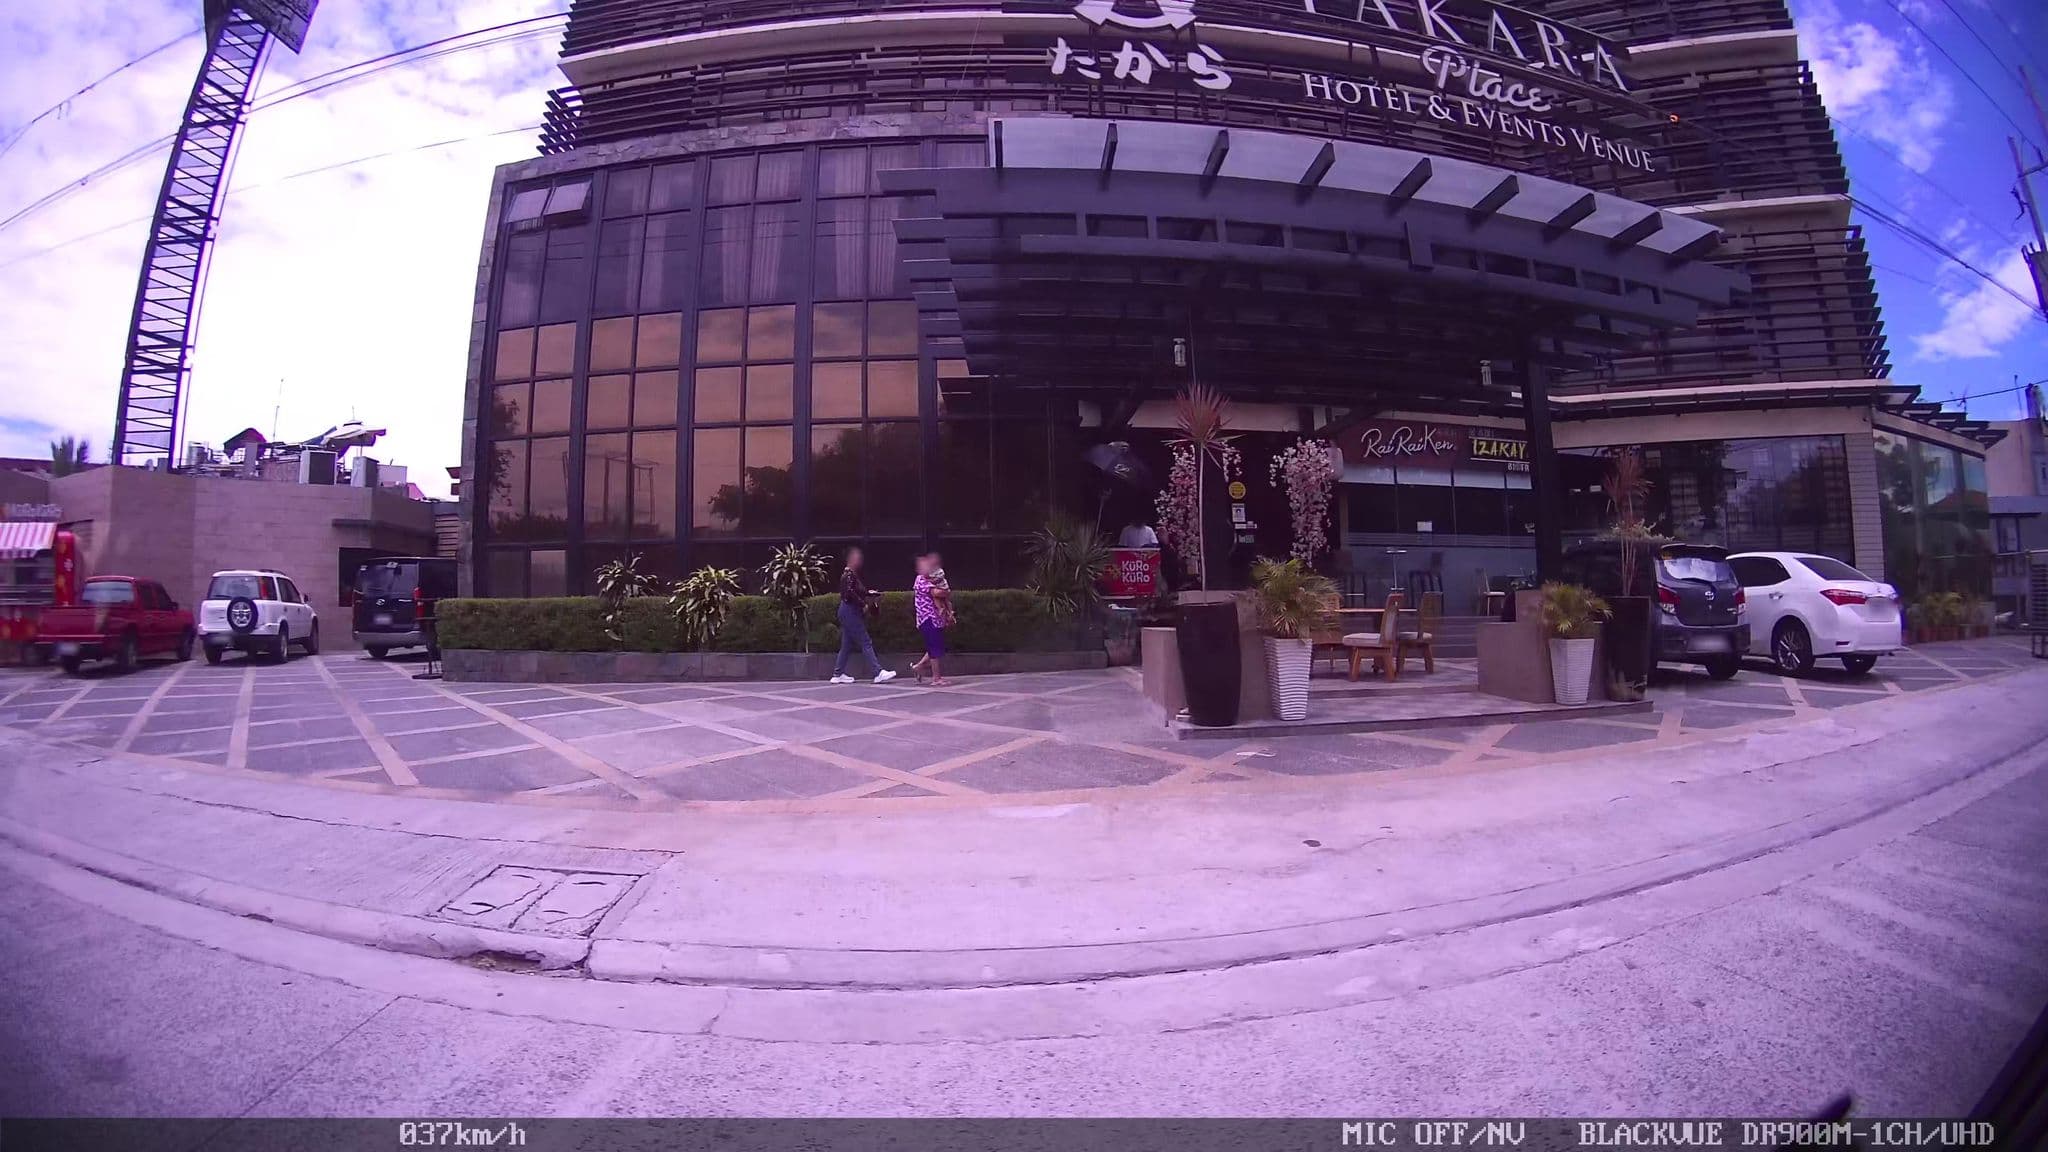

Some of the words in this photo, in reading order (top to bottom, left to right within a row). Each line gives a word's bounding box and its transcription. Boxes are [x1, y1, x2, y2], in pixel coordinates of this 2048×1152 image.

[1049, 37, 1232, 90] たから
[1420, 44, 1551, 112] Place
[1301, 72, 1416, 114] HOTEL
[1428, 95, 1455, 122] &
[1462, 99, 1567, 147] EVENTS
[1569, 127, 1656, 173] VENUE
